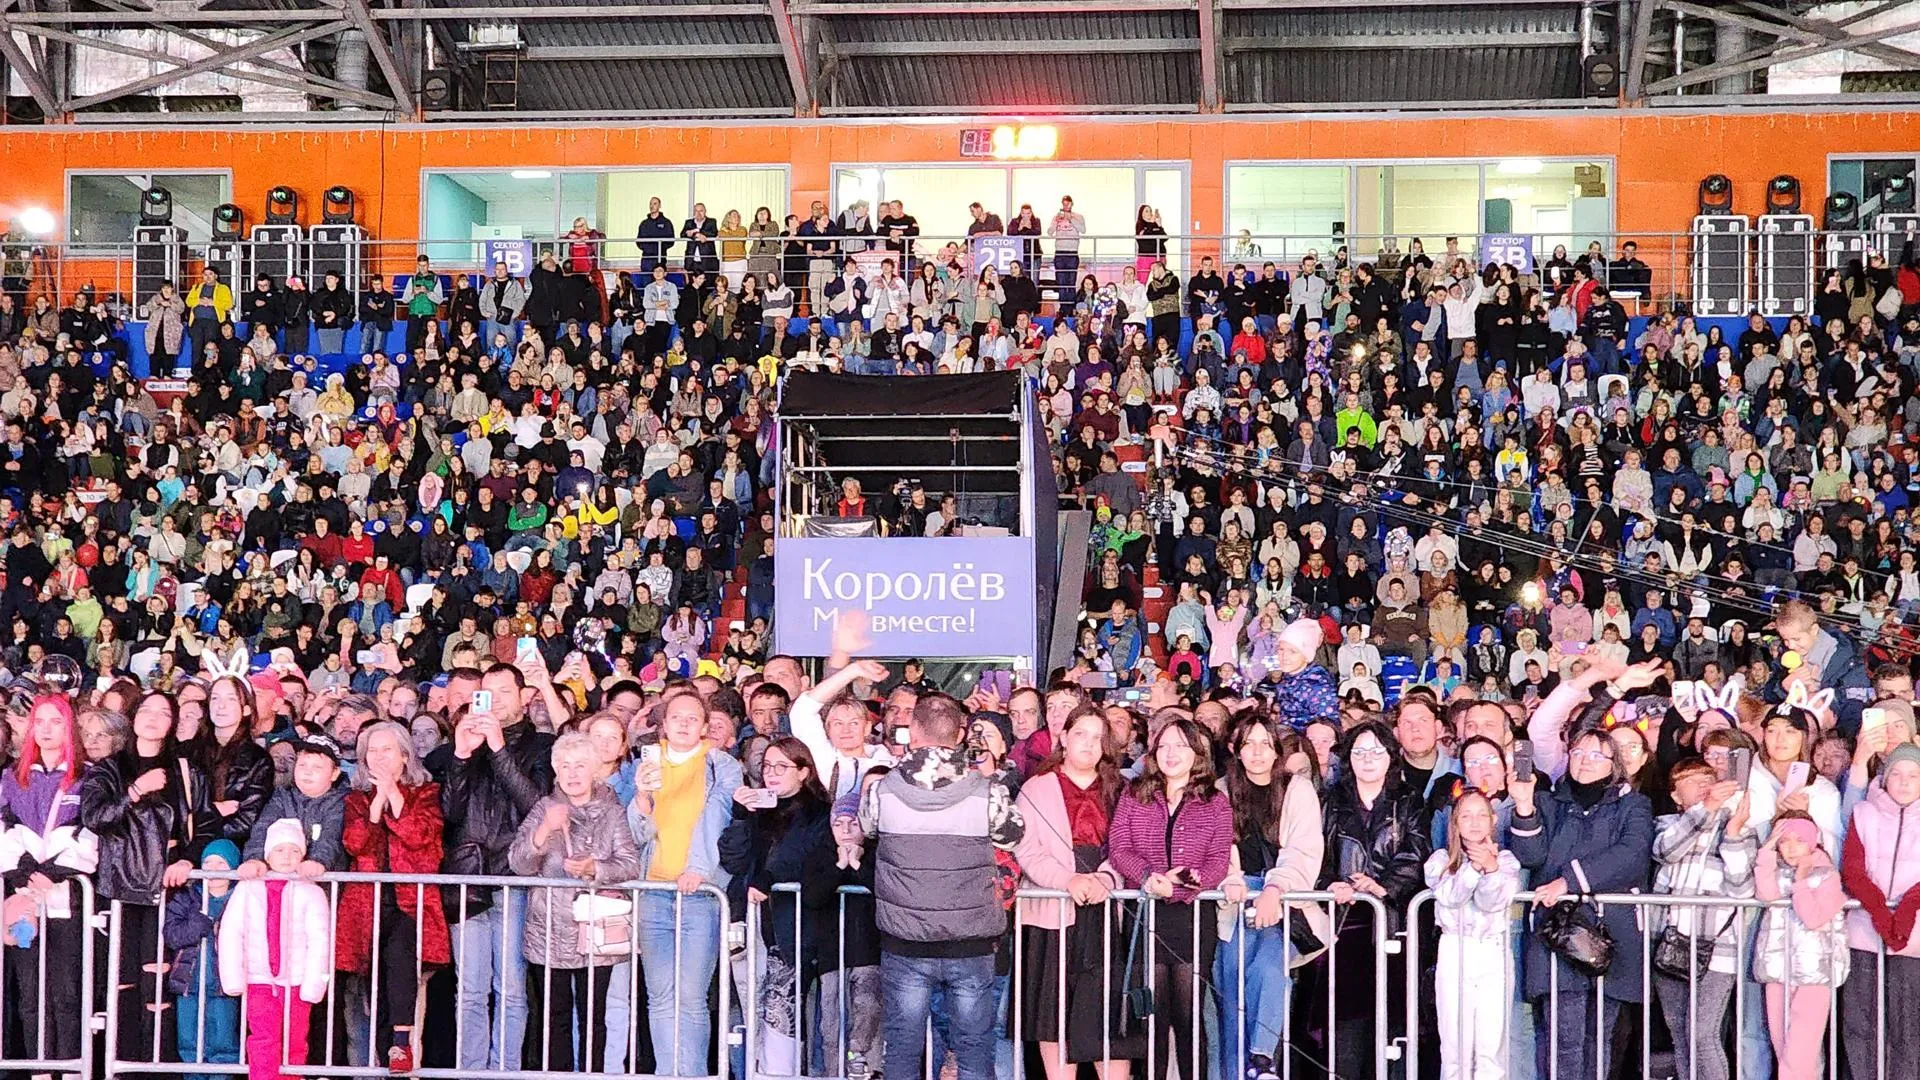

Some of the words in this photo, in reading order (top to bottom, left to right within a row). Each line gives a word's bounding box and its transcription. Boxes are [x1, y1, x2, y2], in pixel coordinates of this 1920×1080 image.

[493, 241, 524, 249] СЕКТОР
[983, 238, 1015, 246] СЕКТОР
[1491, 236, 1525, 245] СЕКТОР
[803, 558, 1005, 612] Королёв
[813, 606, 862, 632] М
[872, 607, 975, 633] вместе!
